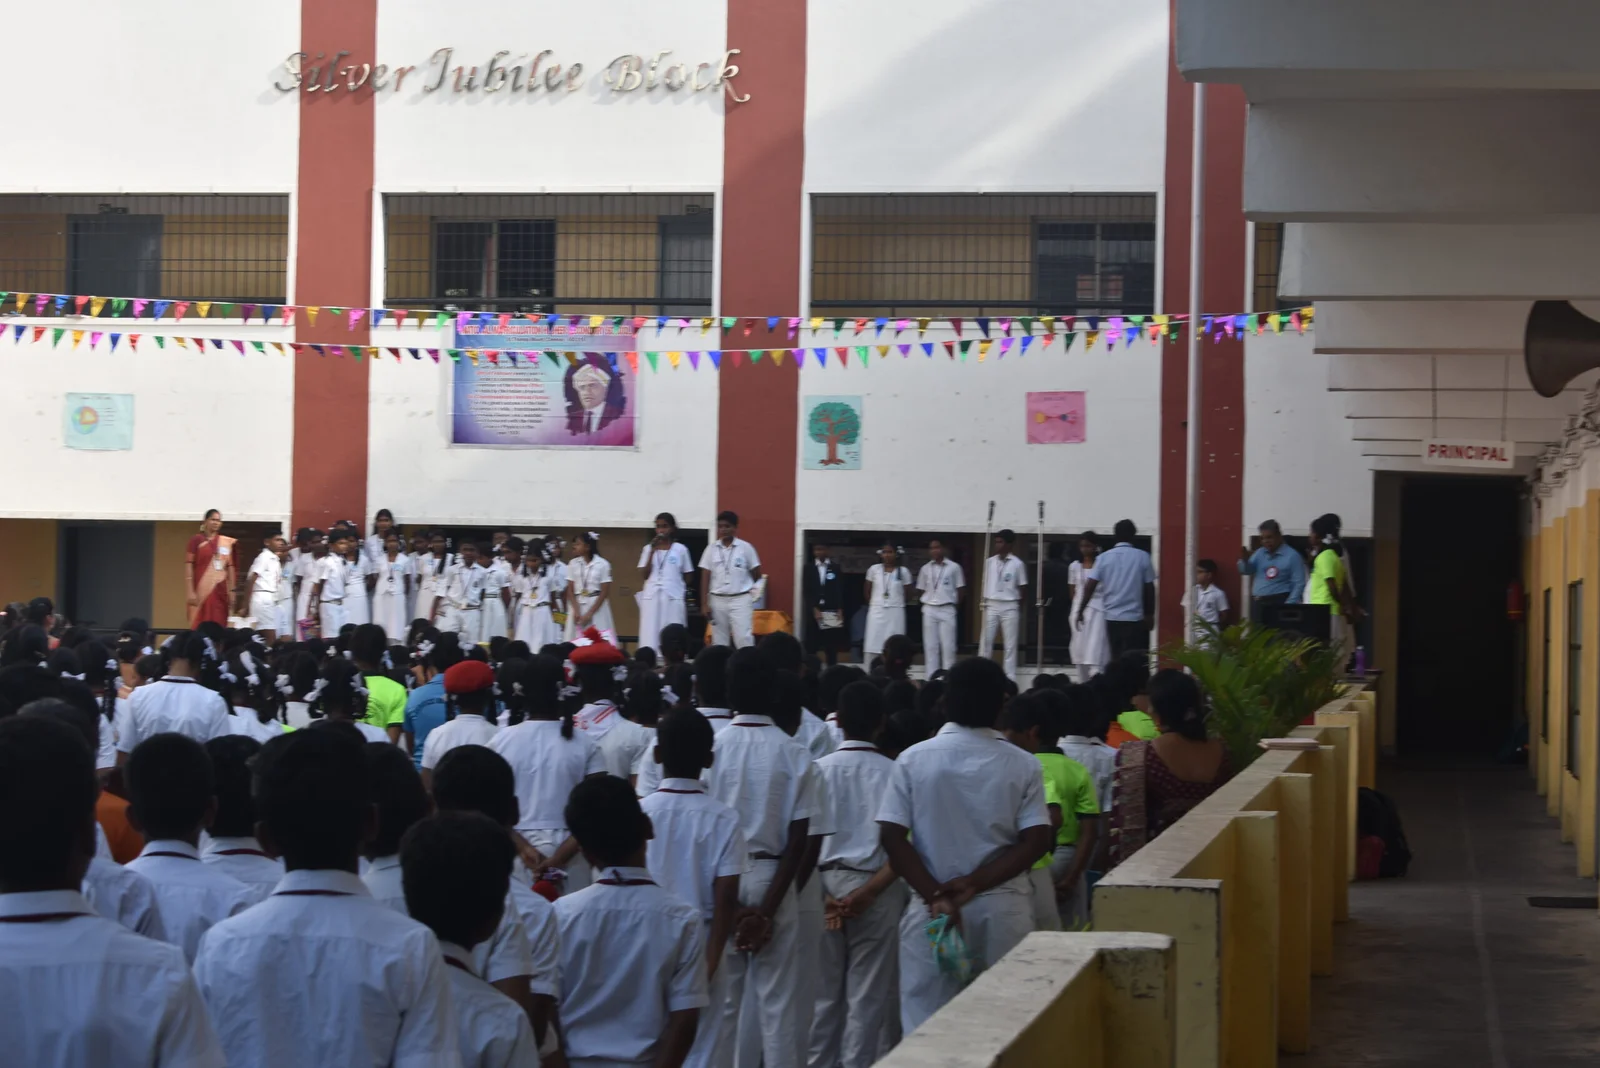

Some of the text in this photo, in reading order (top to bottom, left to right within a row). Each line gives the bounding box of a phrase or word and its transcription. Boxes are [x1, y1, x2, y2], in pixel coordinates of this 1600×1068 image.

[273, 47, 752, 103] Silver Jubilee Block
[1428, 444, 1508, 462] PRINCIPAL
